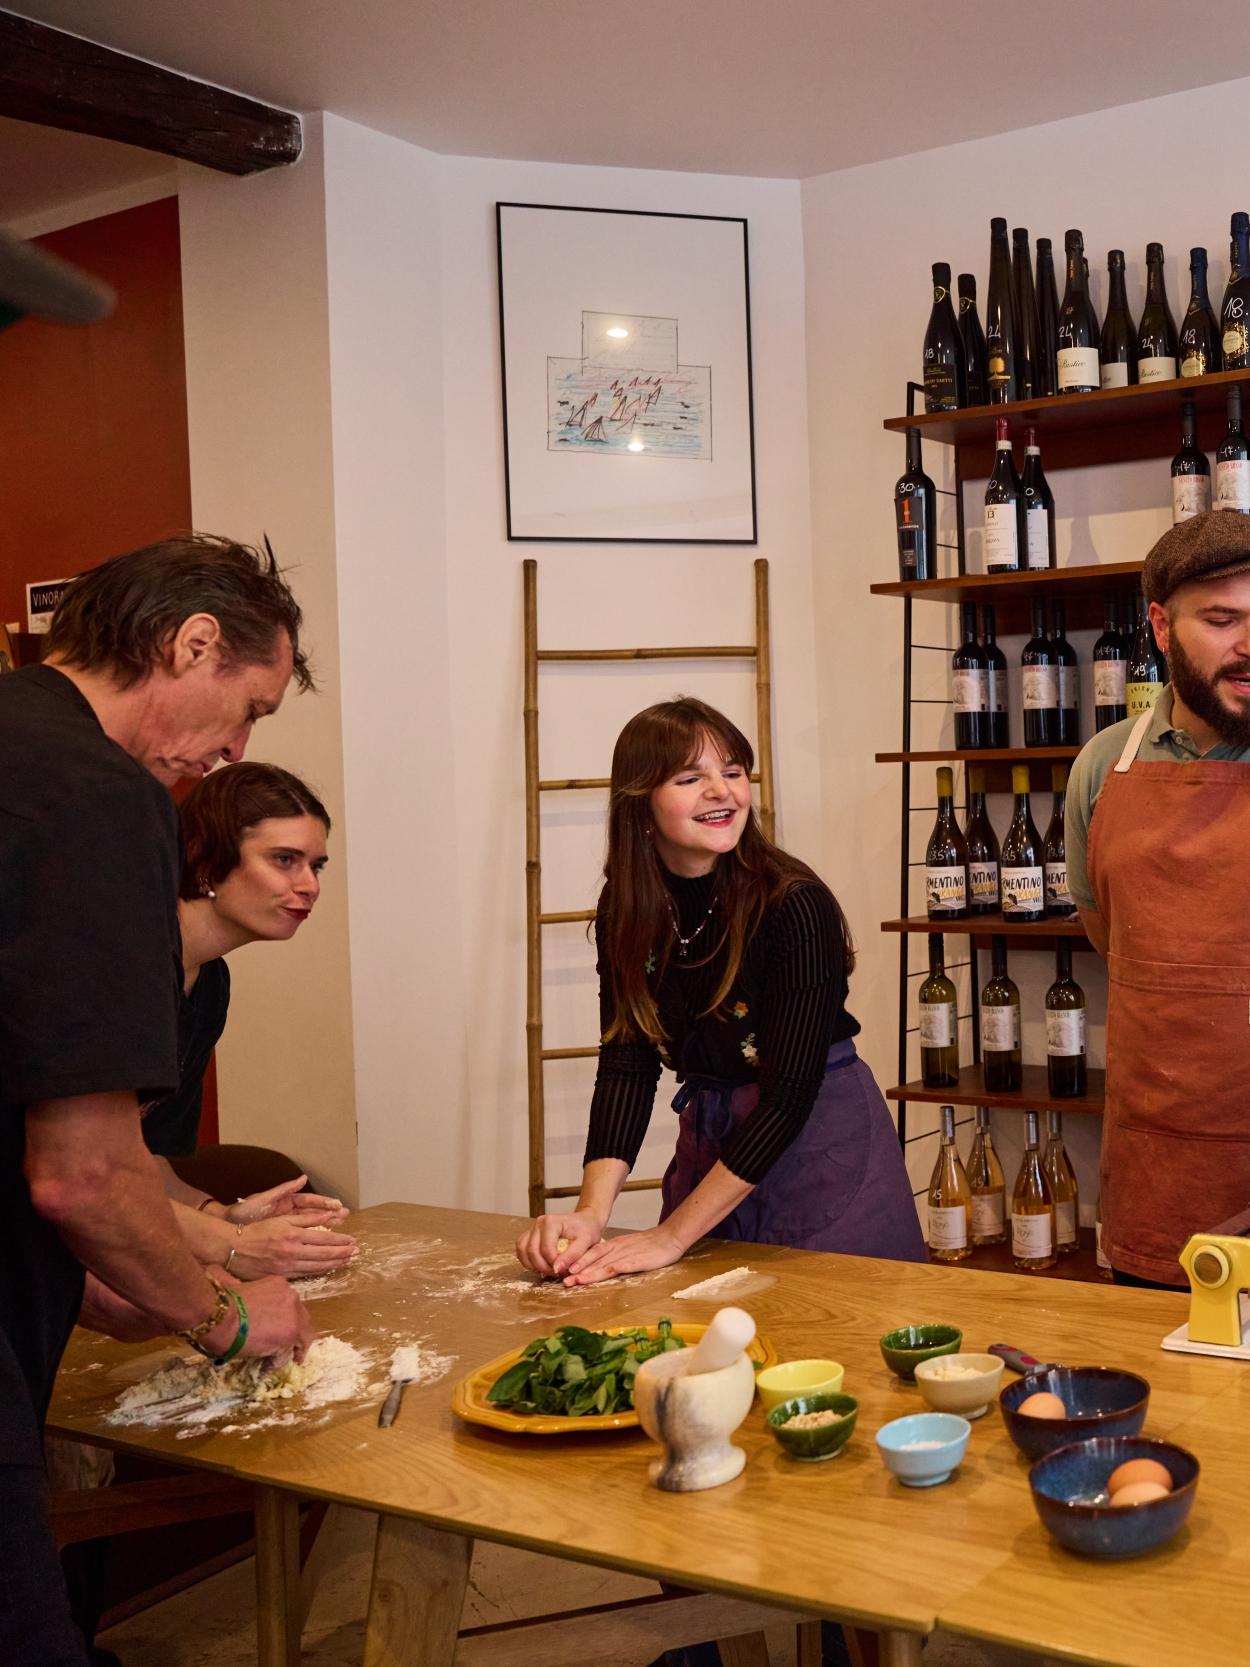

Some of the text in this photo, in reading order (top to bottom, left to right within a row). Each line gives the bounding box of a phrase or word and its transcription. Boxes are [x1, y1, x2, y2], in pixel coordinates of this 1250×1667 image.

[1224, 297, 1244, 319] 18
[1183, 328, 1196, 344] 18
[1134, 664, 1146, 676] 19
